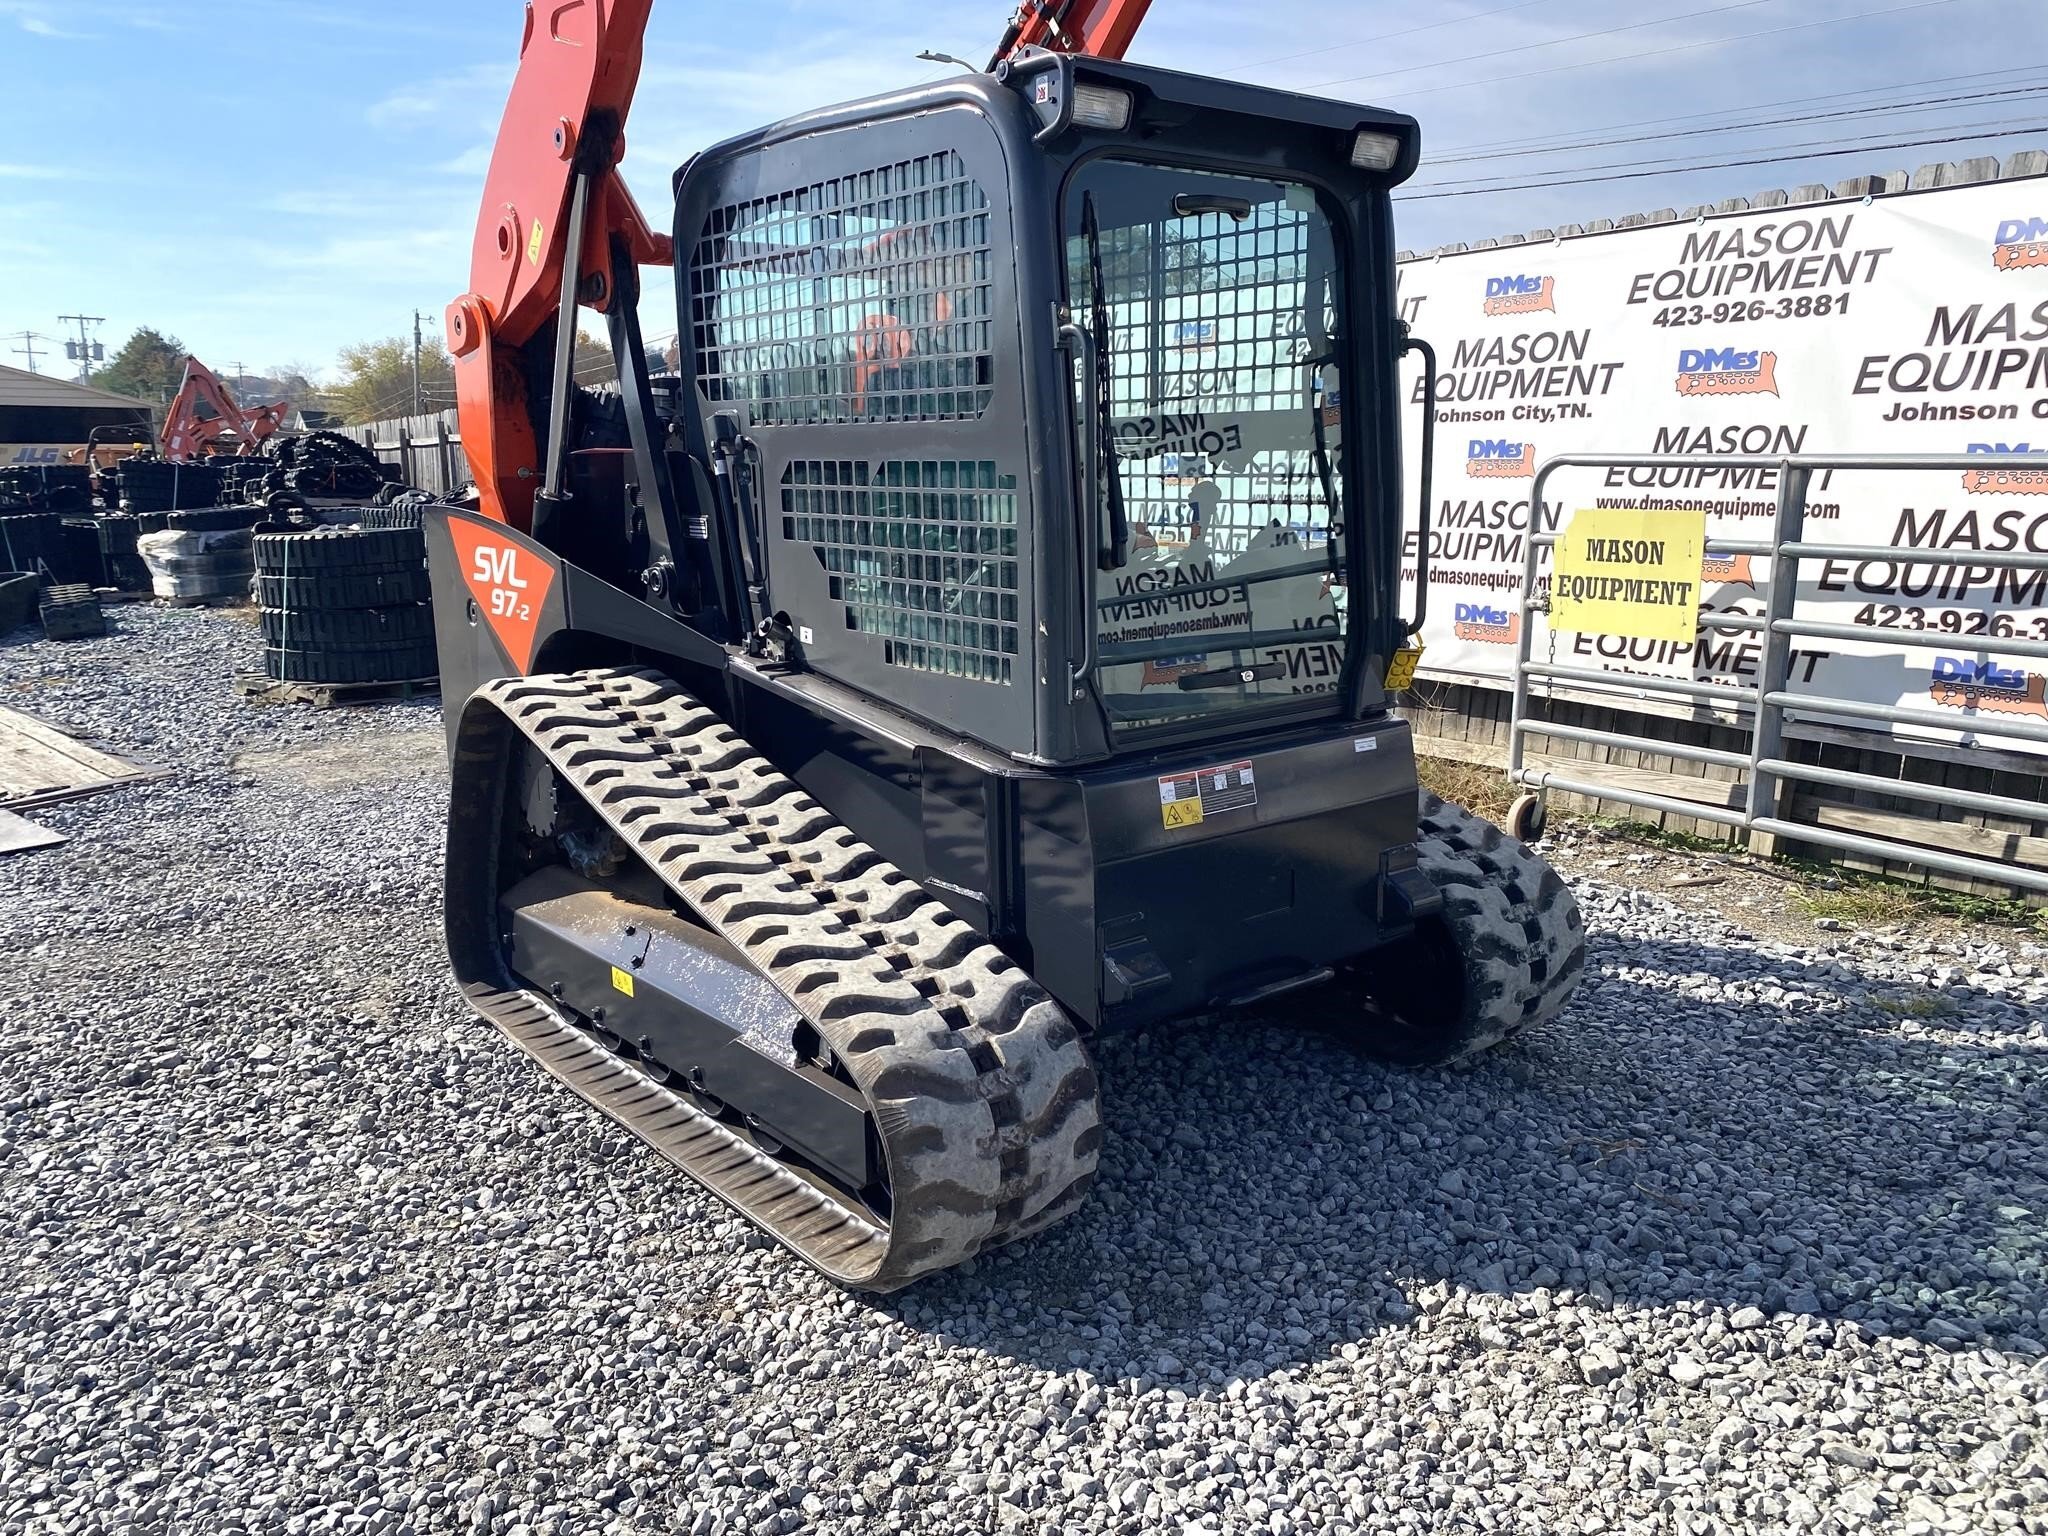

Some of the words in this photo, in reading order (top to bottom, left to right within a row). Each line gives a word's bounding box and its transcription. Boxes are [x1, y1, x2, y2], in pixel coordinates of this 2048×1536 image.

[1679, 214, 1854, 264] MASON
[1627, 247, 1894, 304] EQUIPMENT
[1652, 292, 1850, 328] 423-926-3881
[1452, 328, 1592, 369] MASON
[1411, 362, 1624, 404] EQUIPMENT
[1433, 407, 1505, 423] Johnson
[1882, 401, 2018, 421] Johnson
[12, 447, 60, 463] JLG
[1652, 425, 1808, 453] MASON
[1438, 500, 1563, 531] MASON
[473, 546, 527, 588] SVL
[1586, 538, 1665, 565] MASON
[491, 588, 530, 621] 97-2
[1557, 575, 1692, 606] EQUIPMENT
